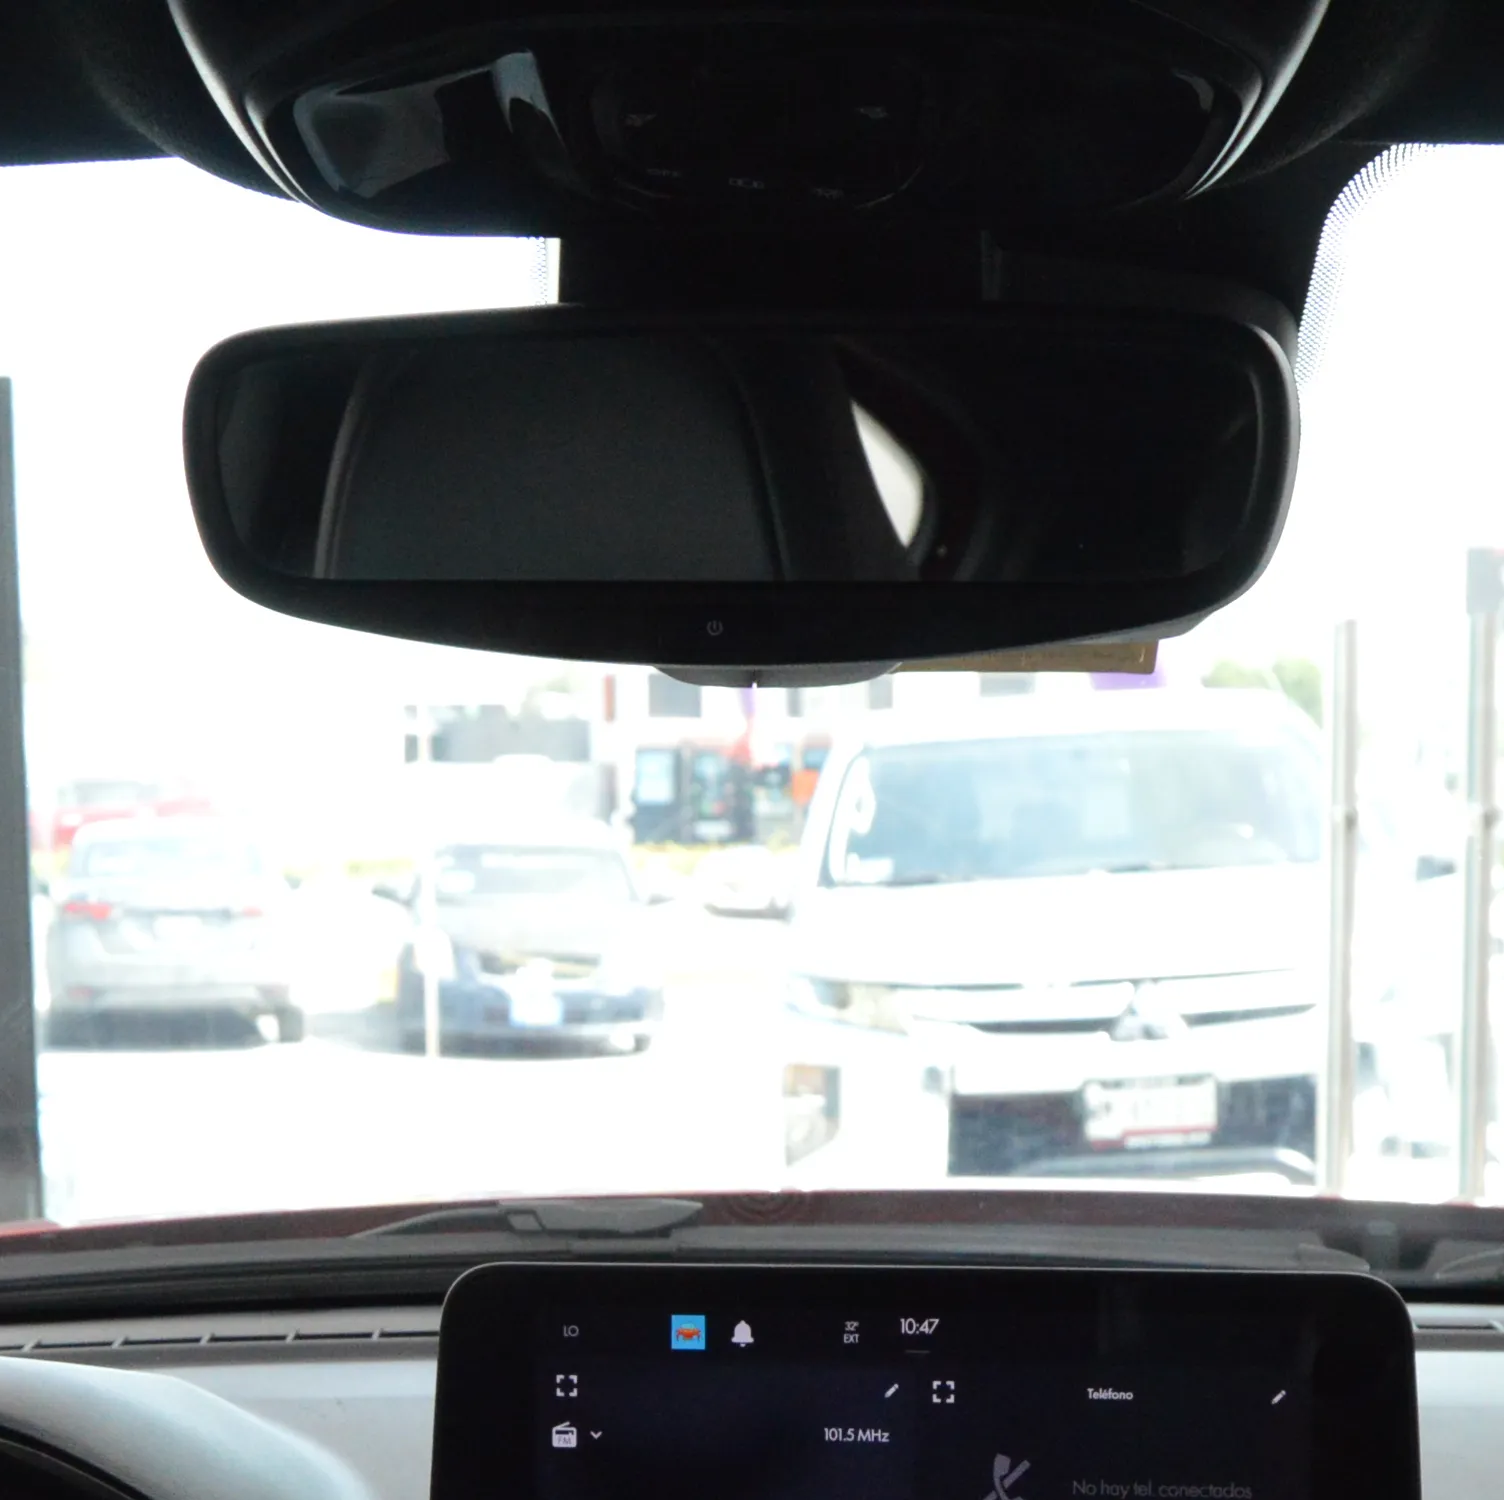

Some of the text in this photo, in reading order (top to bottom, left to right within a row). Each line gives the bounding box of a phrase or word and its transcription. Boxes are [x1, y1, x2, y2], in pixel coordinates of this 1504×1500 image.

[564, 1325, 579, 1337] LO
[900, 1317, 939, 1334] 10:47
[844, 1334, 859, 1343] EXT
[1087, 1388, 1133, 1400] Teléfono
[825, 1428, 889, 1442] 101.5 MHz
[1073, 1480, 1252, 1499] No hay tel. conectados
